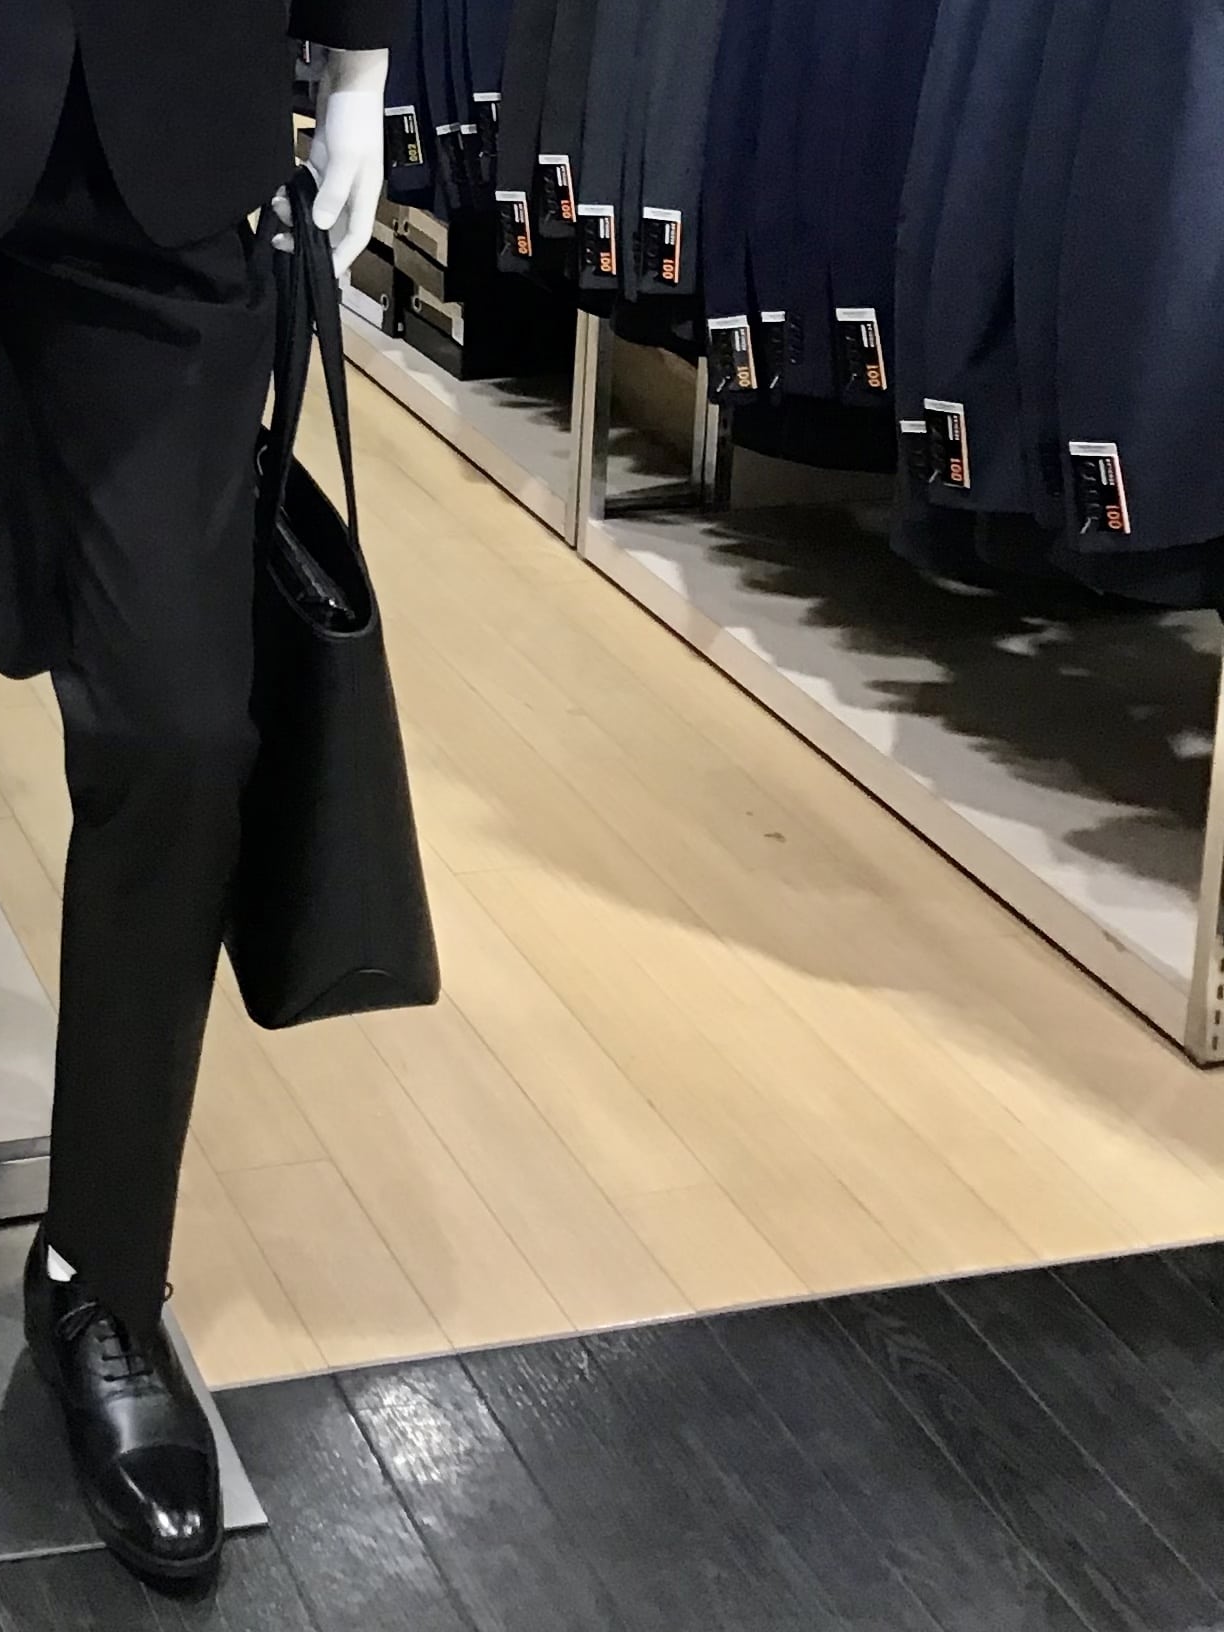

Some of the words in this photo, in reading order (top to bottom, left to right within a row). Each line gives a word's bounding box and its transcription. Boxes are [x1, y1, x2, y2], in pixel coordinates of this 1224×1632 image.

[561, 200, 572, 219] 001
[599, 252, 612, 272] 001
[662, 259, 674, 280] 001
[736, 366, 751, 388] 001
[866, 364, 881, 388] 001
[950, 458, 963, 482] 001
[1105, 505, 1123, 530] 001
